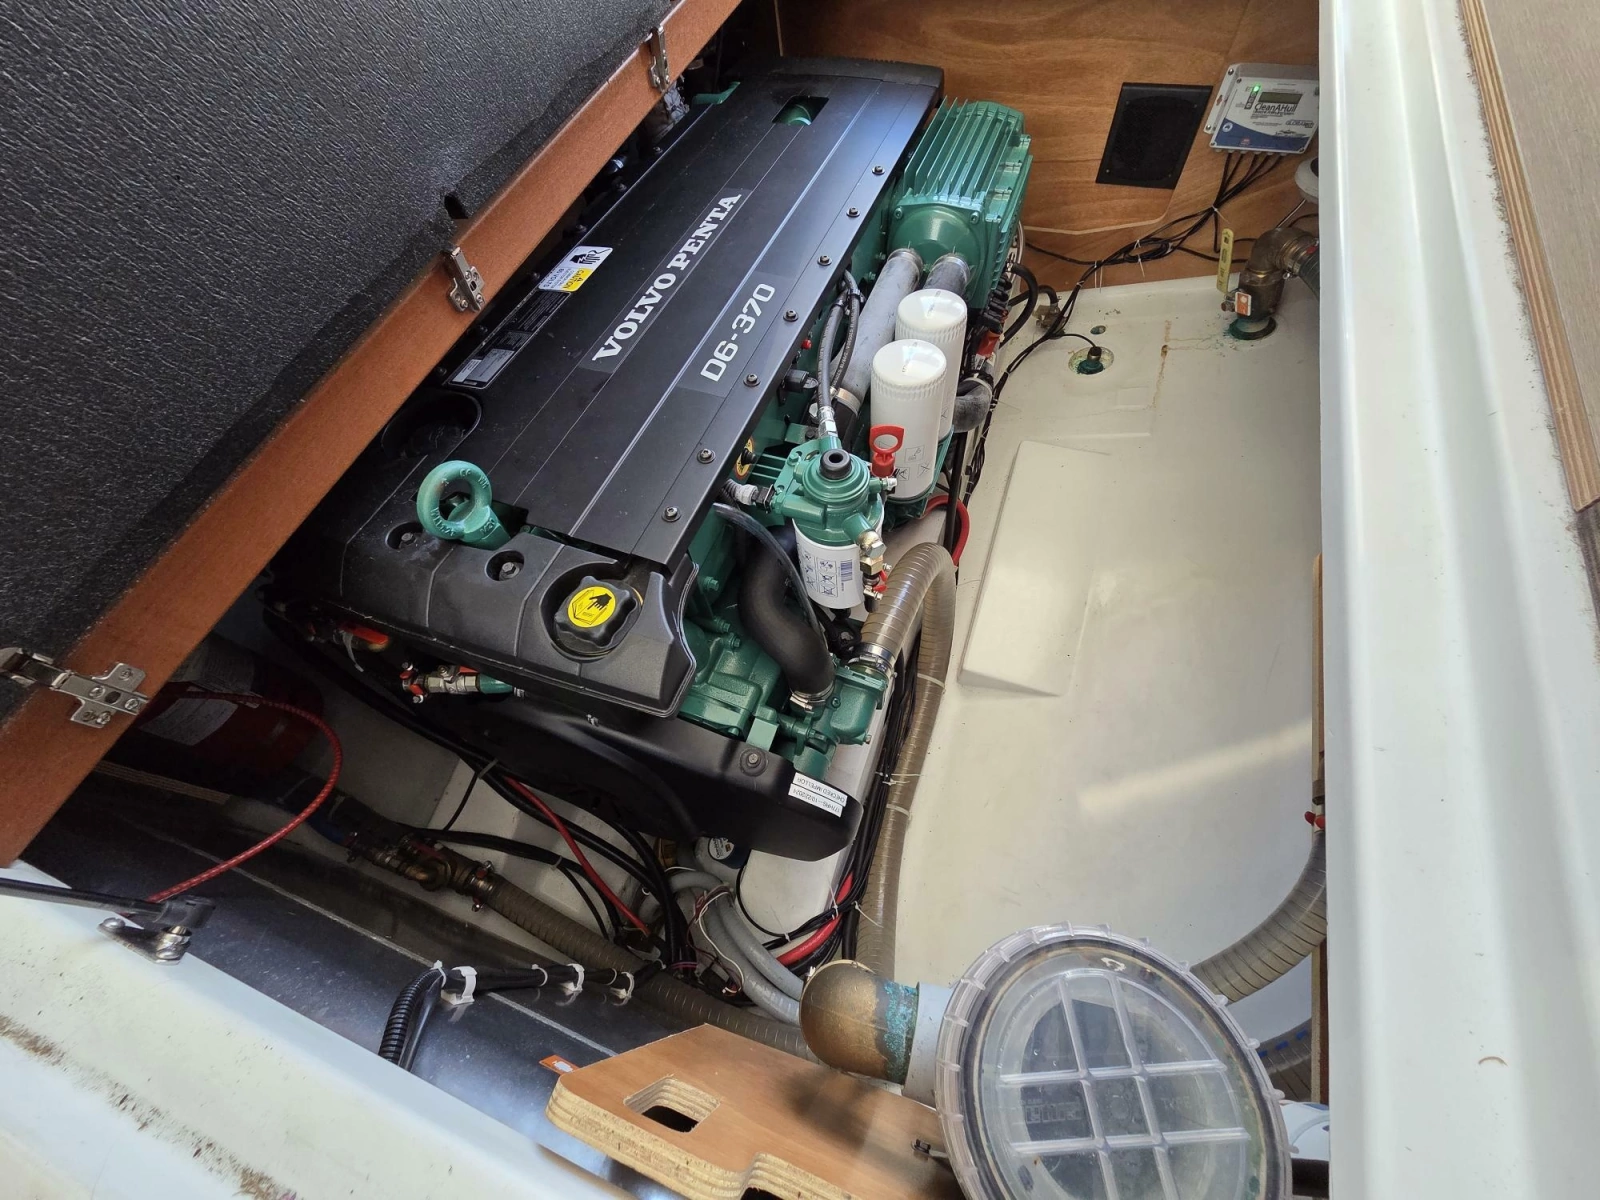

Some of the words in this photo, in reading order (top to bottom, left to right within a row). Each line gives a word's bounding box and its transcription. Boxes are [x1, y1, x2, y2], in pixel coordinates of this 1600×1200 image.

[1254, 103, 1297, 112] CleanAHull
[592, 273, 676, 361] VOLVO
[667, 194, 742, 271] PENTA
[700, 283, 776, 382] D6-370
